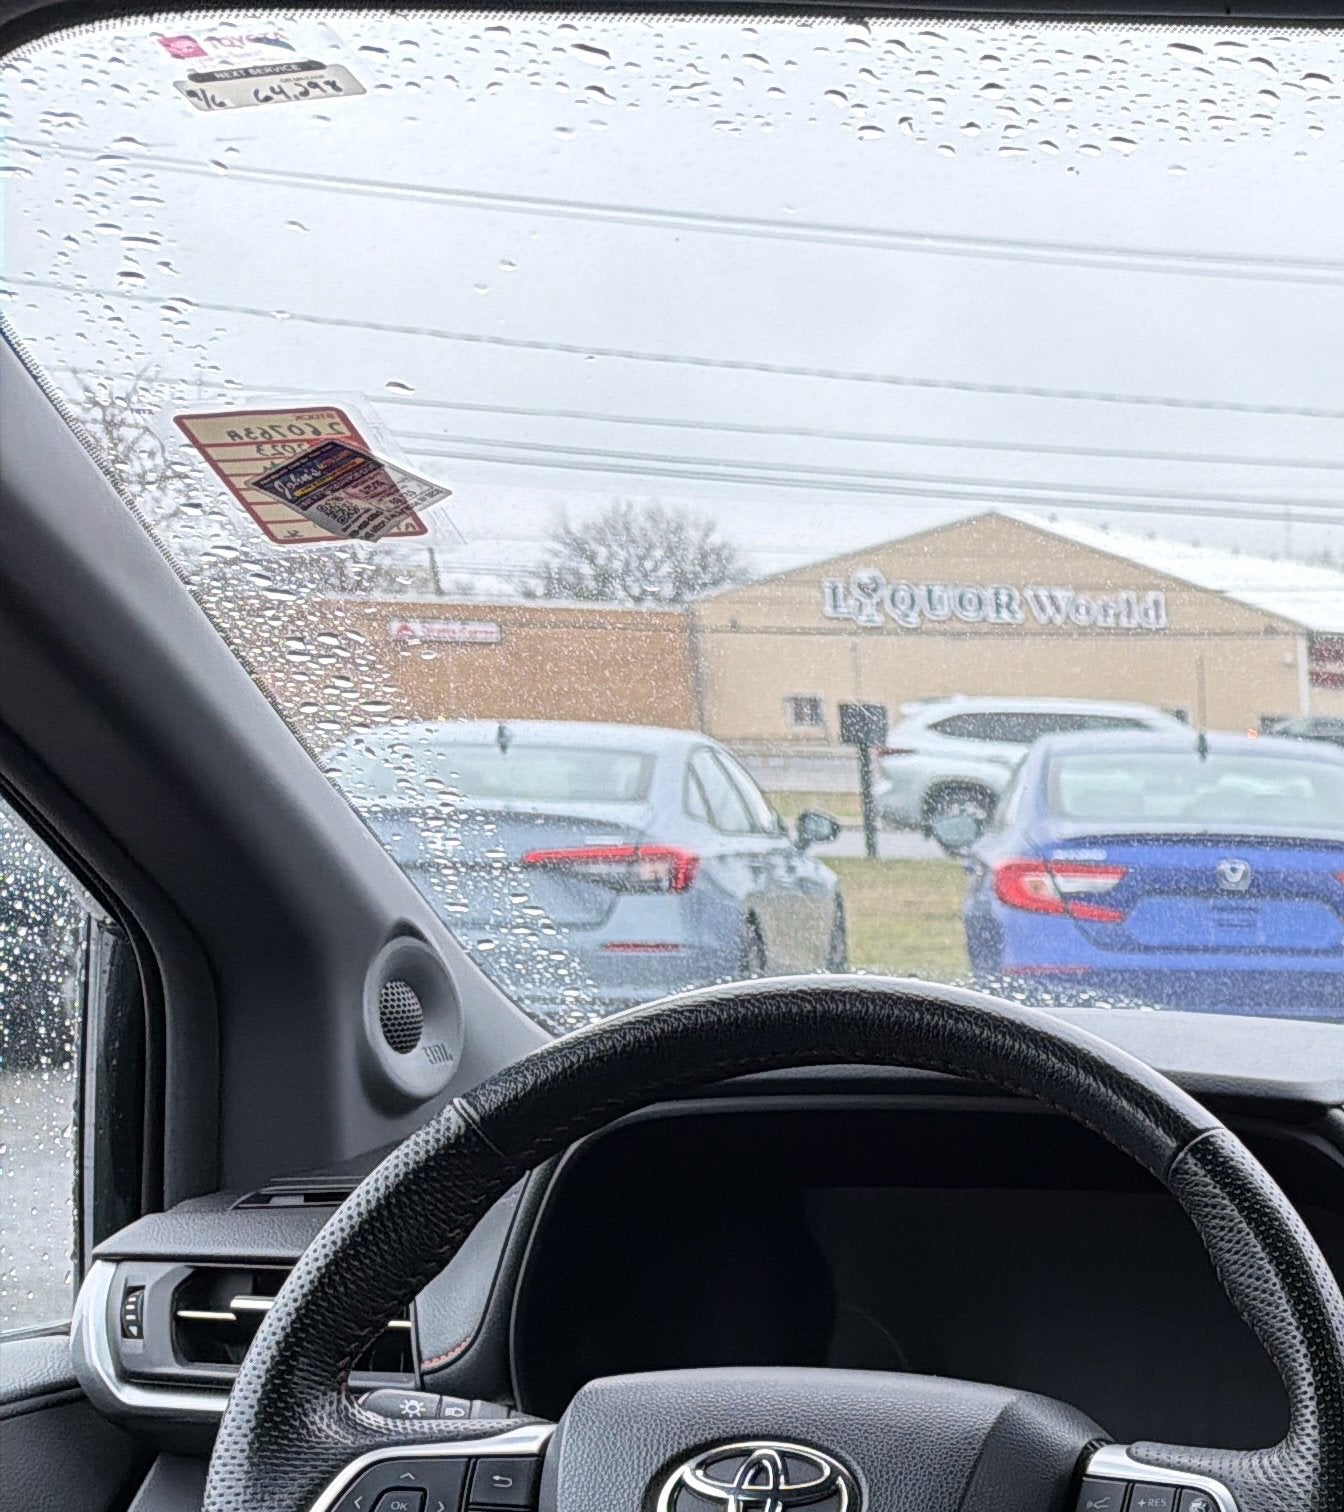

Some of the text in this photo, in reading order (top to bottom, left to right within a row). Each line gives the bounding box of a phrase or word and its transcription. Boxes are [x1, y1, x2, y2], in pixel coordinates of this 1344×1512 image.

[213, 63, 301, 80] NEXT SERVICE
[274, 461, 321, 500] John's
[1023, 586, 1169, 629] World
[421, 1043, 453, 1065] JBL
[390, 1500, 408, 1511] OK
